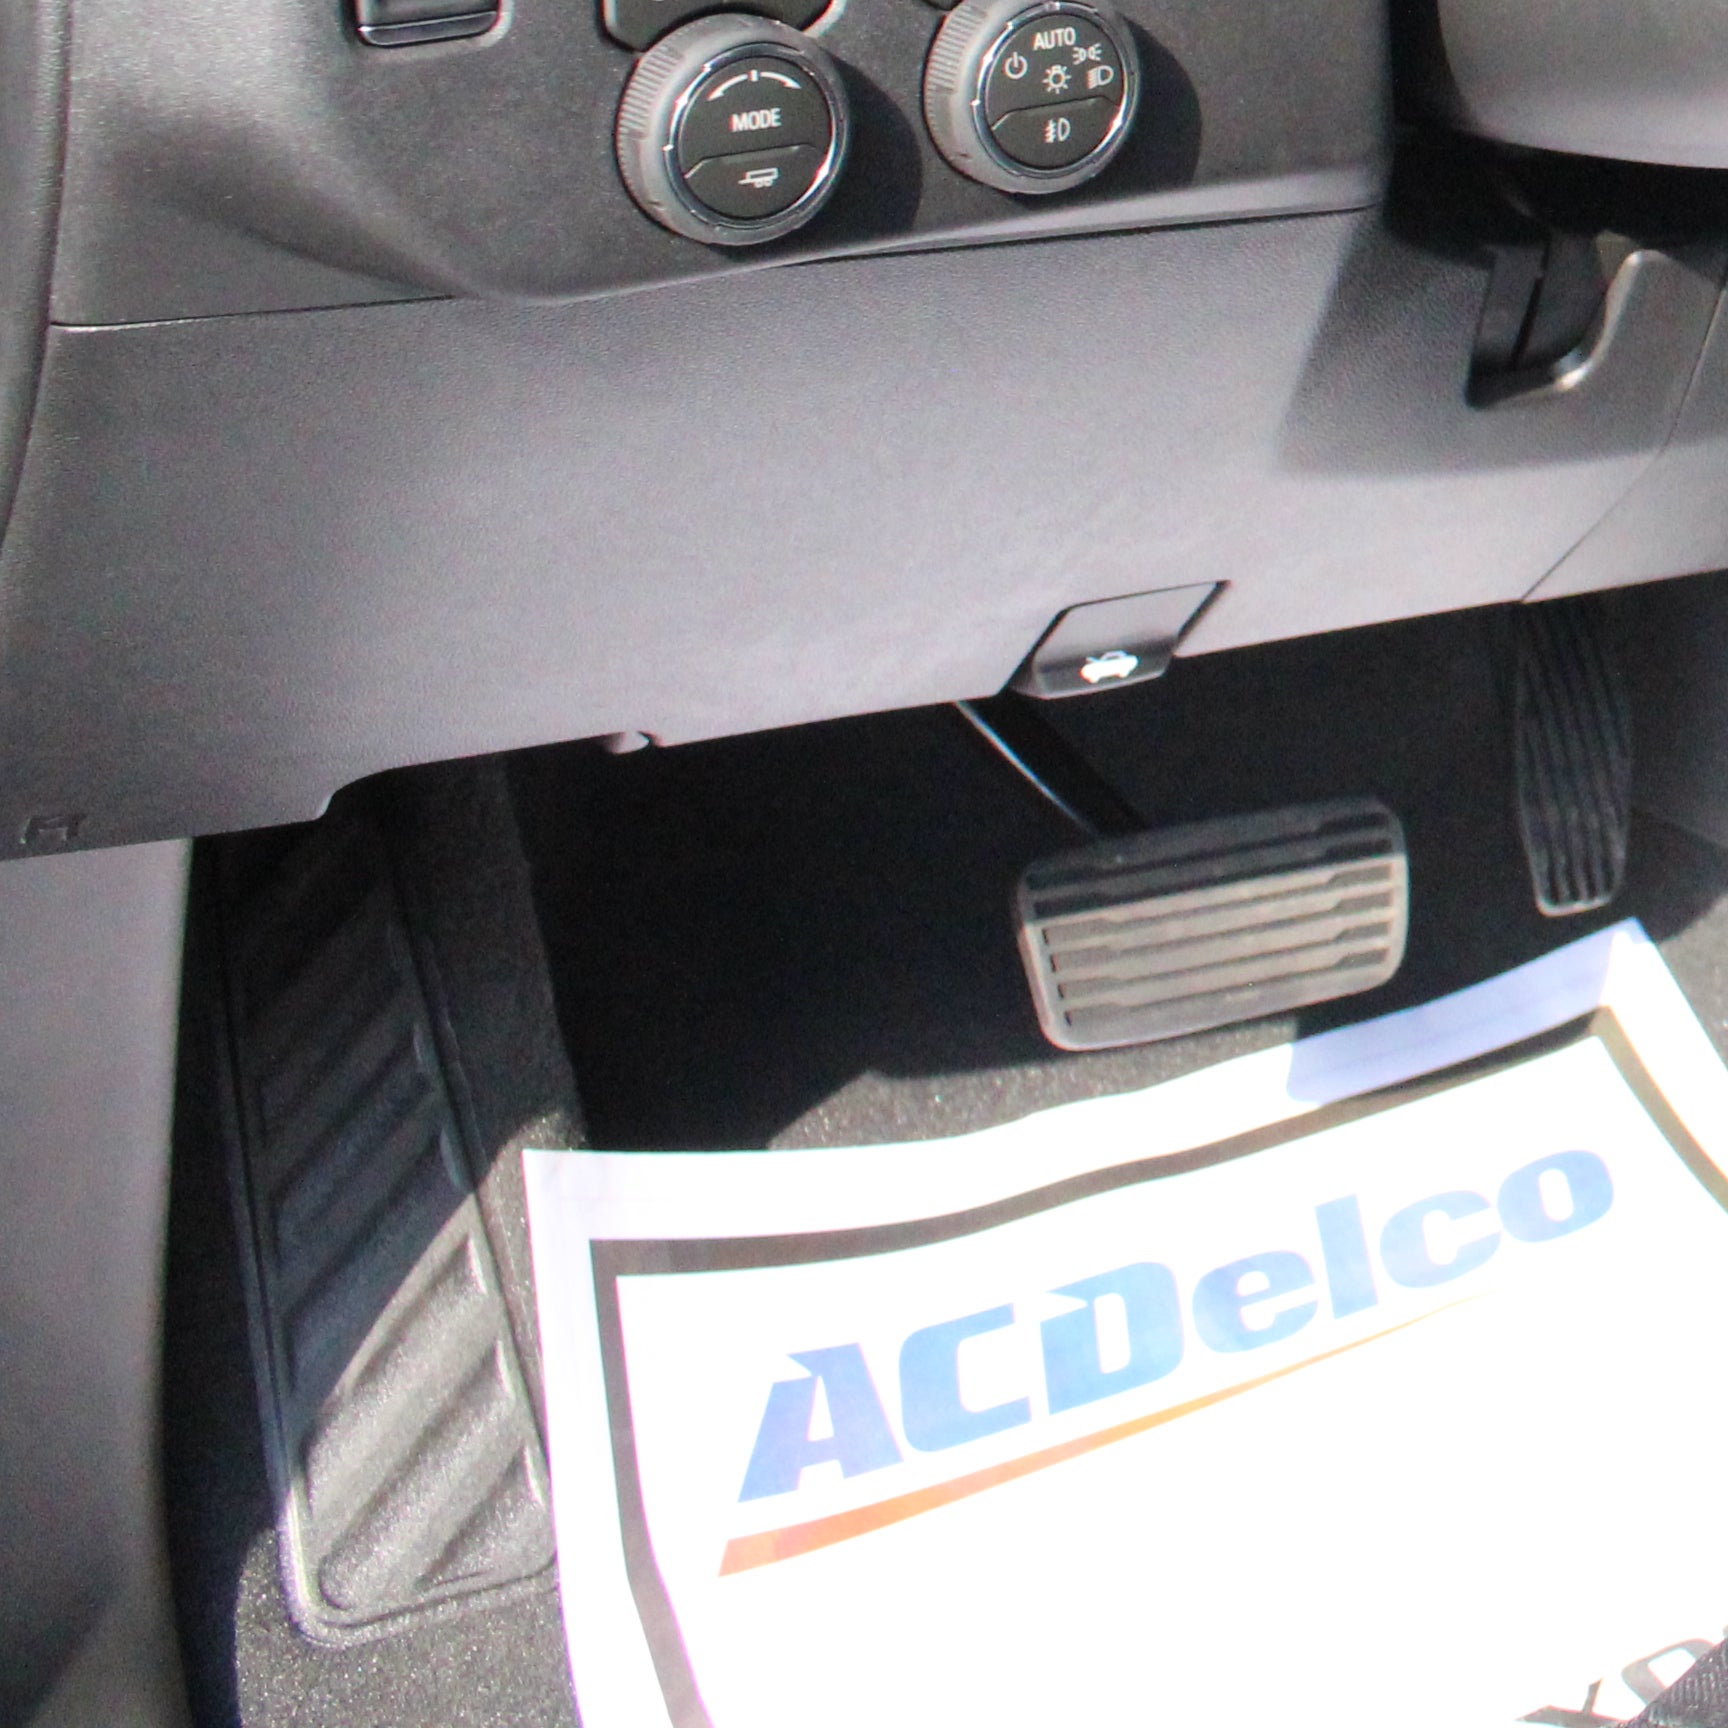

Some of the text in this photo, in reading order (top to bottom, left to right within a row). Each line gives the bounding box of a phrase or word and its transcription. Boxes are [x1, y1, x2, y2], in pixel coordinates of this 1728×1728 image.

[1032, 26, 1076, 50] AUTO
[728, 107, 782, 133] MODE
[737, 1148, 1615, 1503] ACDelco
